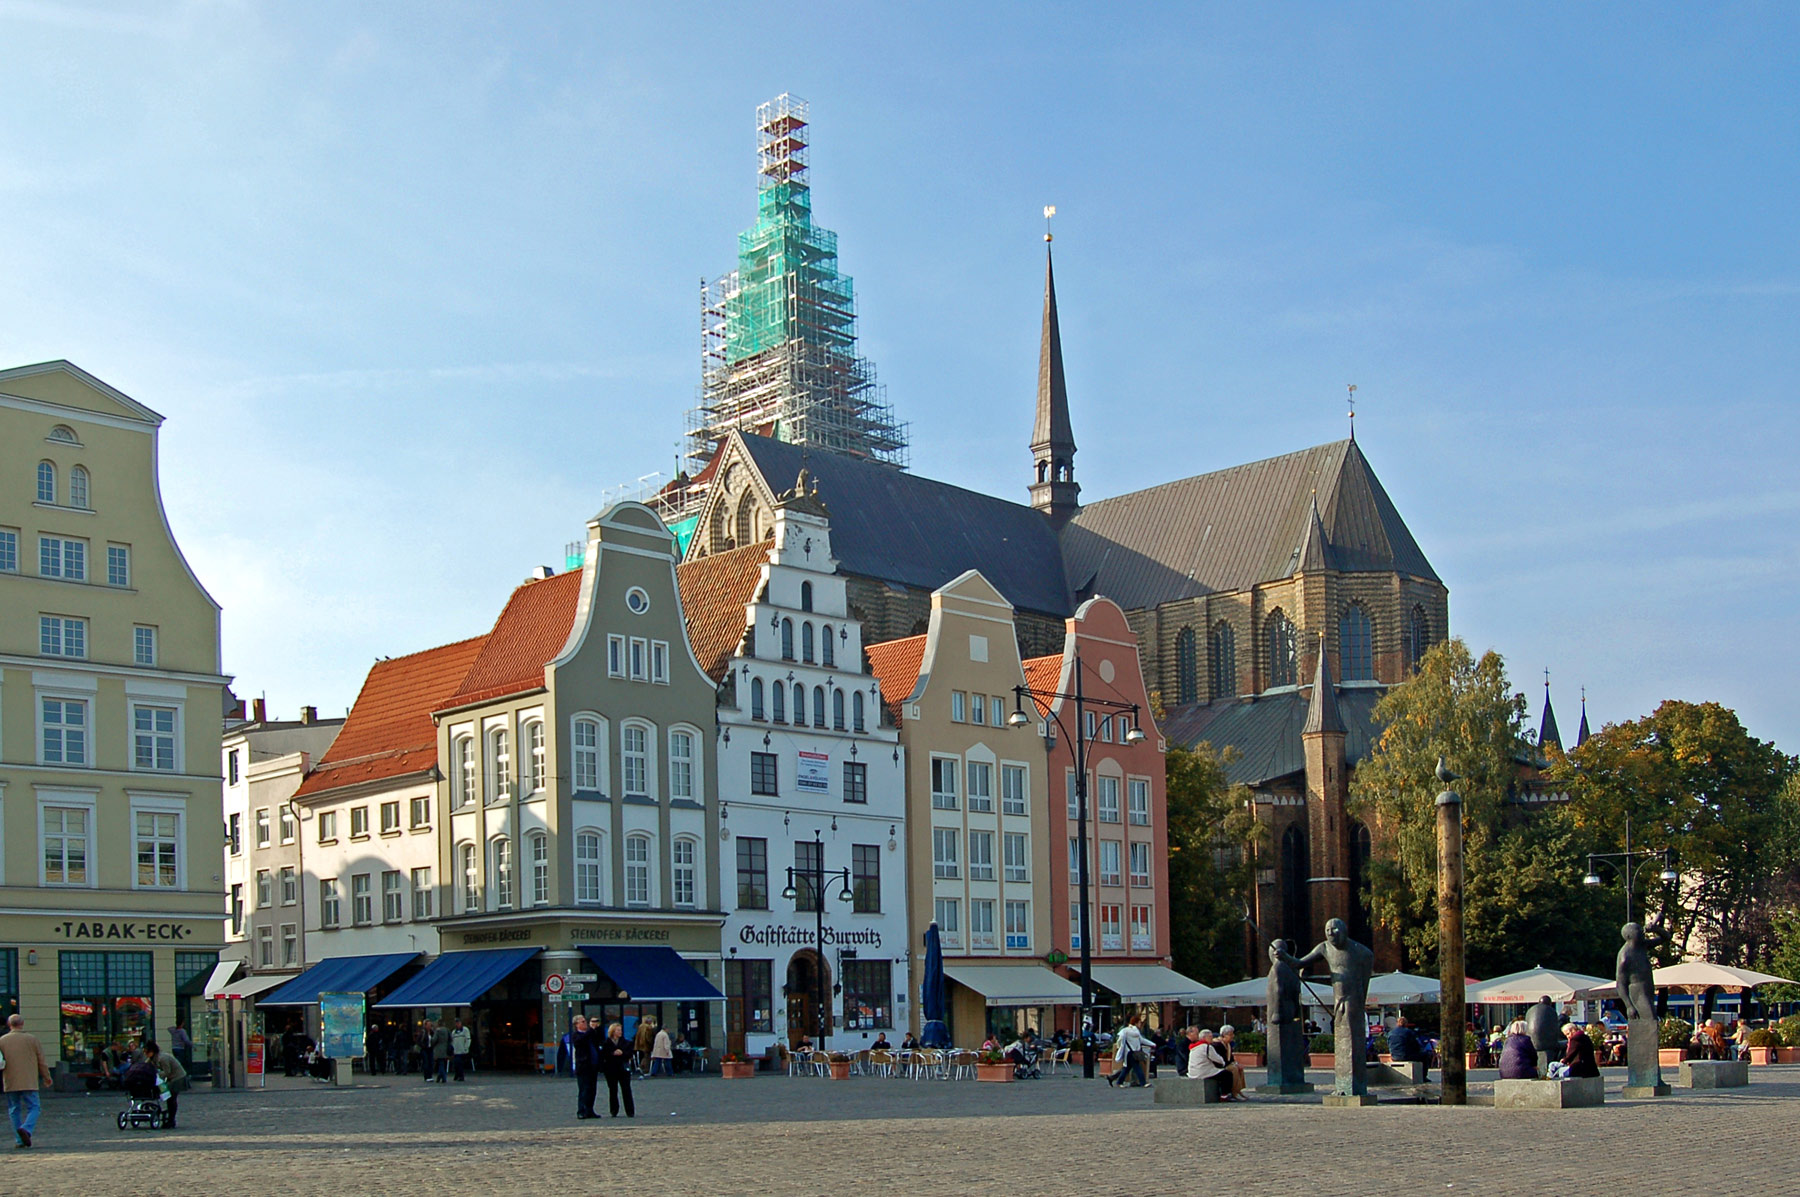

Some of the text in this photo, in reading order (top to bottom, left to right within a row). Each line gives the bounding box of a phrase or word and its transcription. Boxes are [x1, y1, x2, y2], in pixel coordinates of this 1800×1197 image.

[570, 927, 670, 941] STEINOFEN-BÄCKEREI
[739, 924, 882, 948] Gaststätte Burwitz
